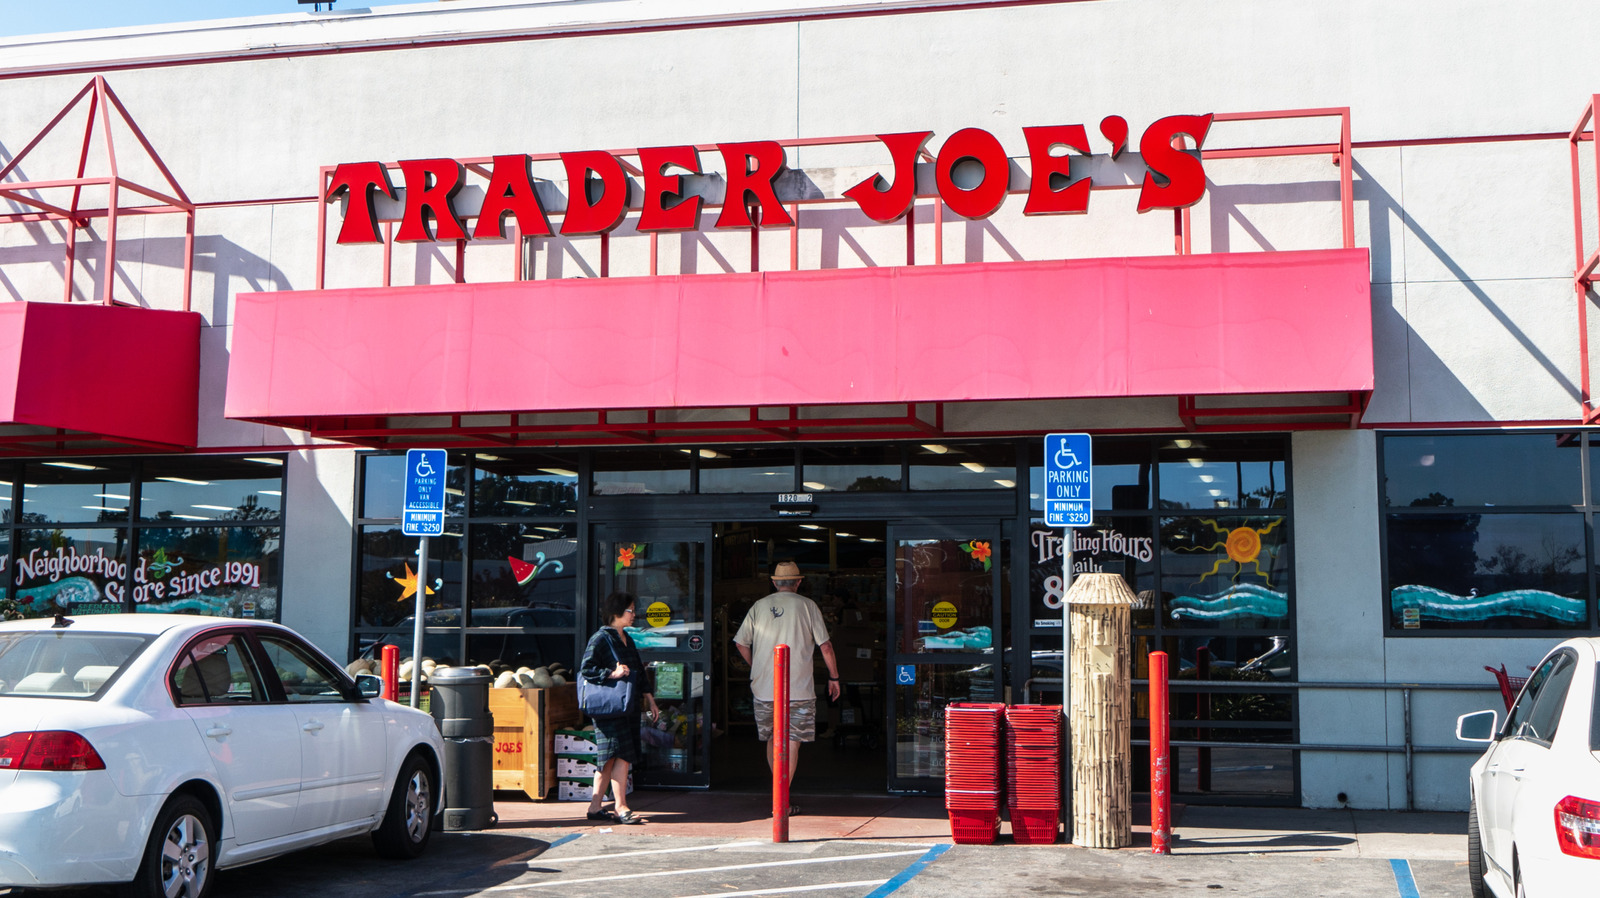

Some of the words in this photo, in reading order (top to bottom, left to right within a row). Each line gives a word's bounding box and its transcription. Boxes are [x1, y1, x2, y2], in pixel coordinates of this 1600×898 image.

[325, 140, 796, 245] TRADER
[841, 112, 1214, 224] JOE'S
[1048, 470, 1089, 483] PARKING
[418, 485, 432, 493] ONLY
[1056, 485, 1081, 498] ONLY
[409, 501, 440, 509] ACCESSIBLE
[1054, 502, 1084, 511] MINIMUM
[410, 513, 437, 522] MINIMUM
[1049, 513, 1064, 522] FINE
[1068, 513, 1089, 522] $250
[406, 523, 419, 532] FINE
[422, 523, 440, 532] $250
[1097, 529, 1153, 563] Hours
[15, 546, 147, 586] Neighborhood
[104, 577, 166, 603] Store
[168, 567, 222, 596] since
[224, 561, 261, 589] 1991
[1042, 575, 1064, 610] 8
